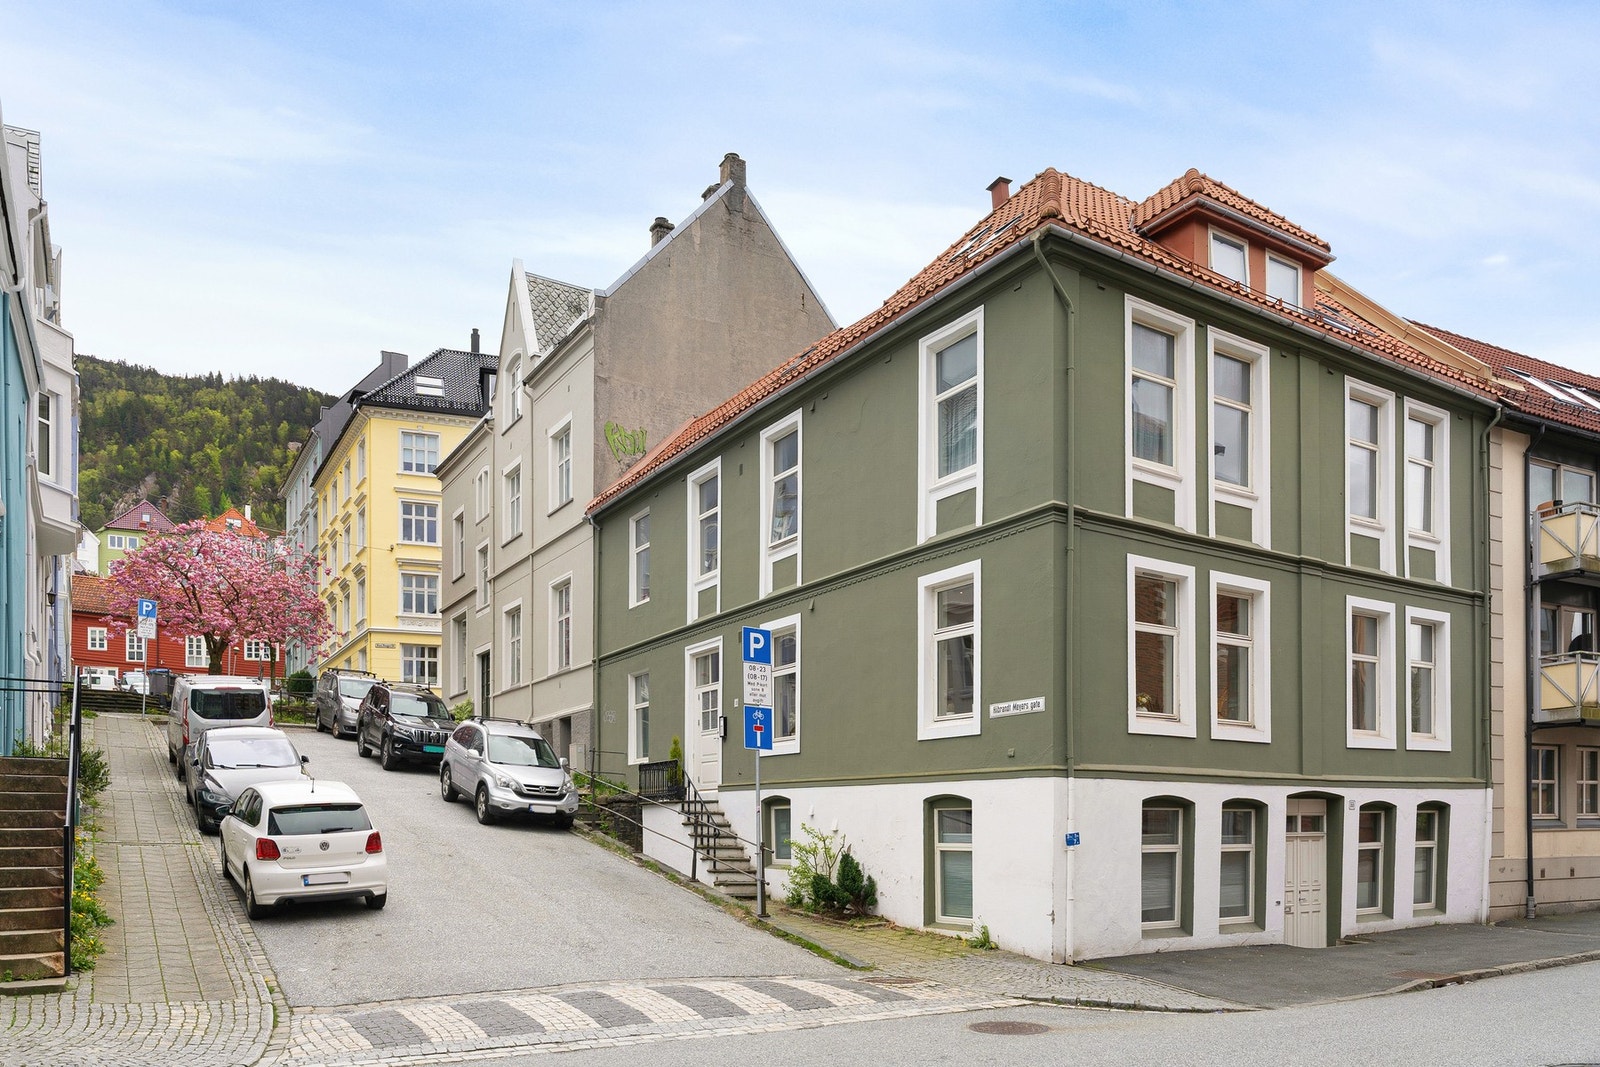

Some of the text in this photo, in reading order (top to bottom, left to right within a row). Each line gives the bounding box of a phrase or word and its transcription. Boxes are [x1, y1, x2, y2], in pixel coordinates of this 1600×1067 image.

[142, 601, 152, 615] P
[749, 631, 765, 658] P
[1012, 703, 1029, 711] Meyers
[1030, 700, 1041, 711] gate
